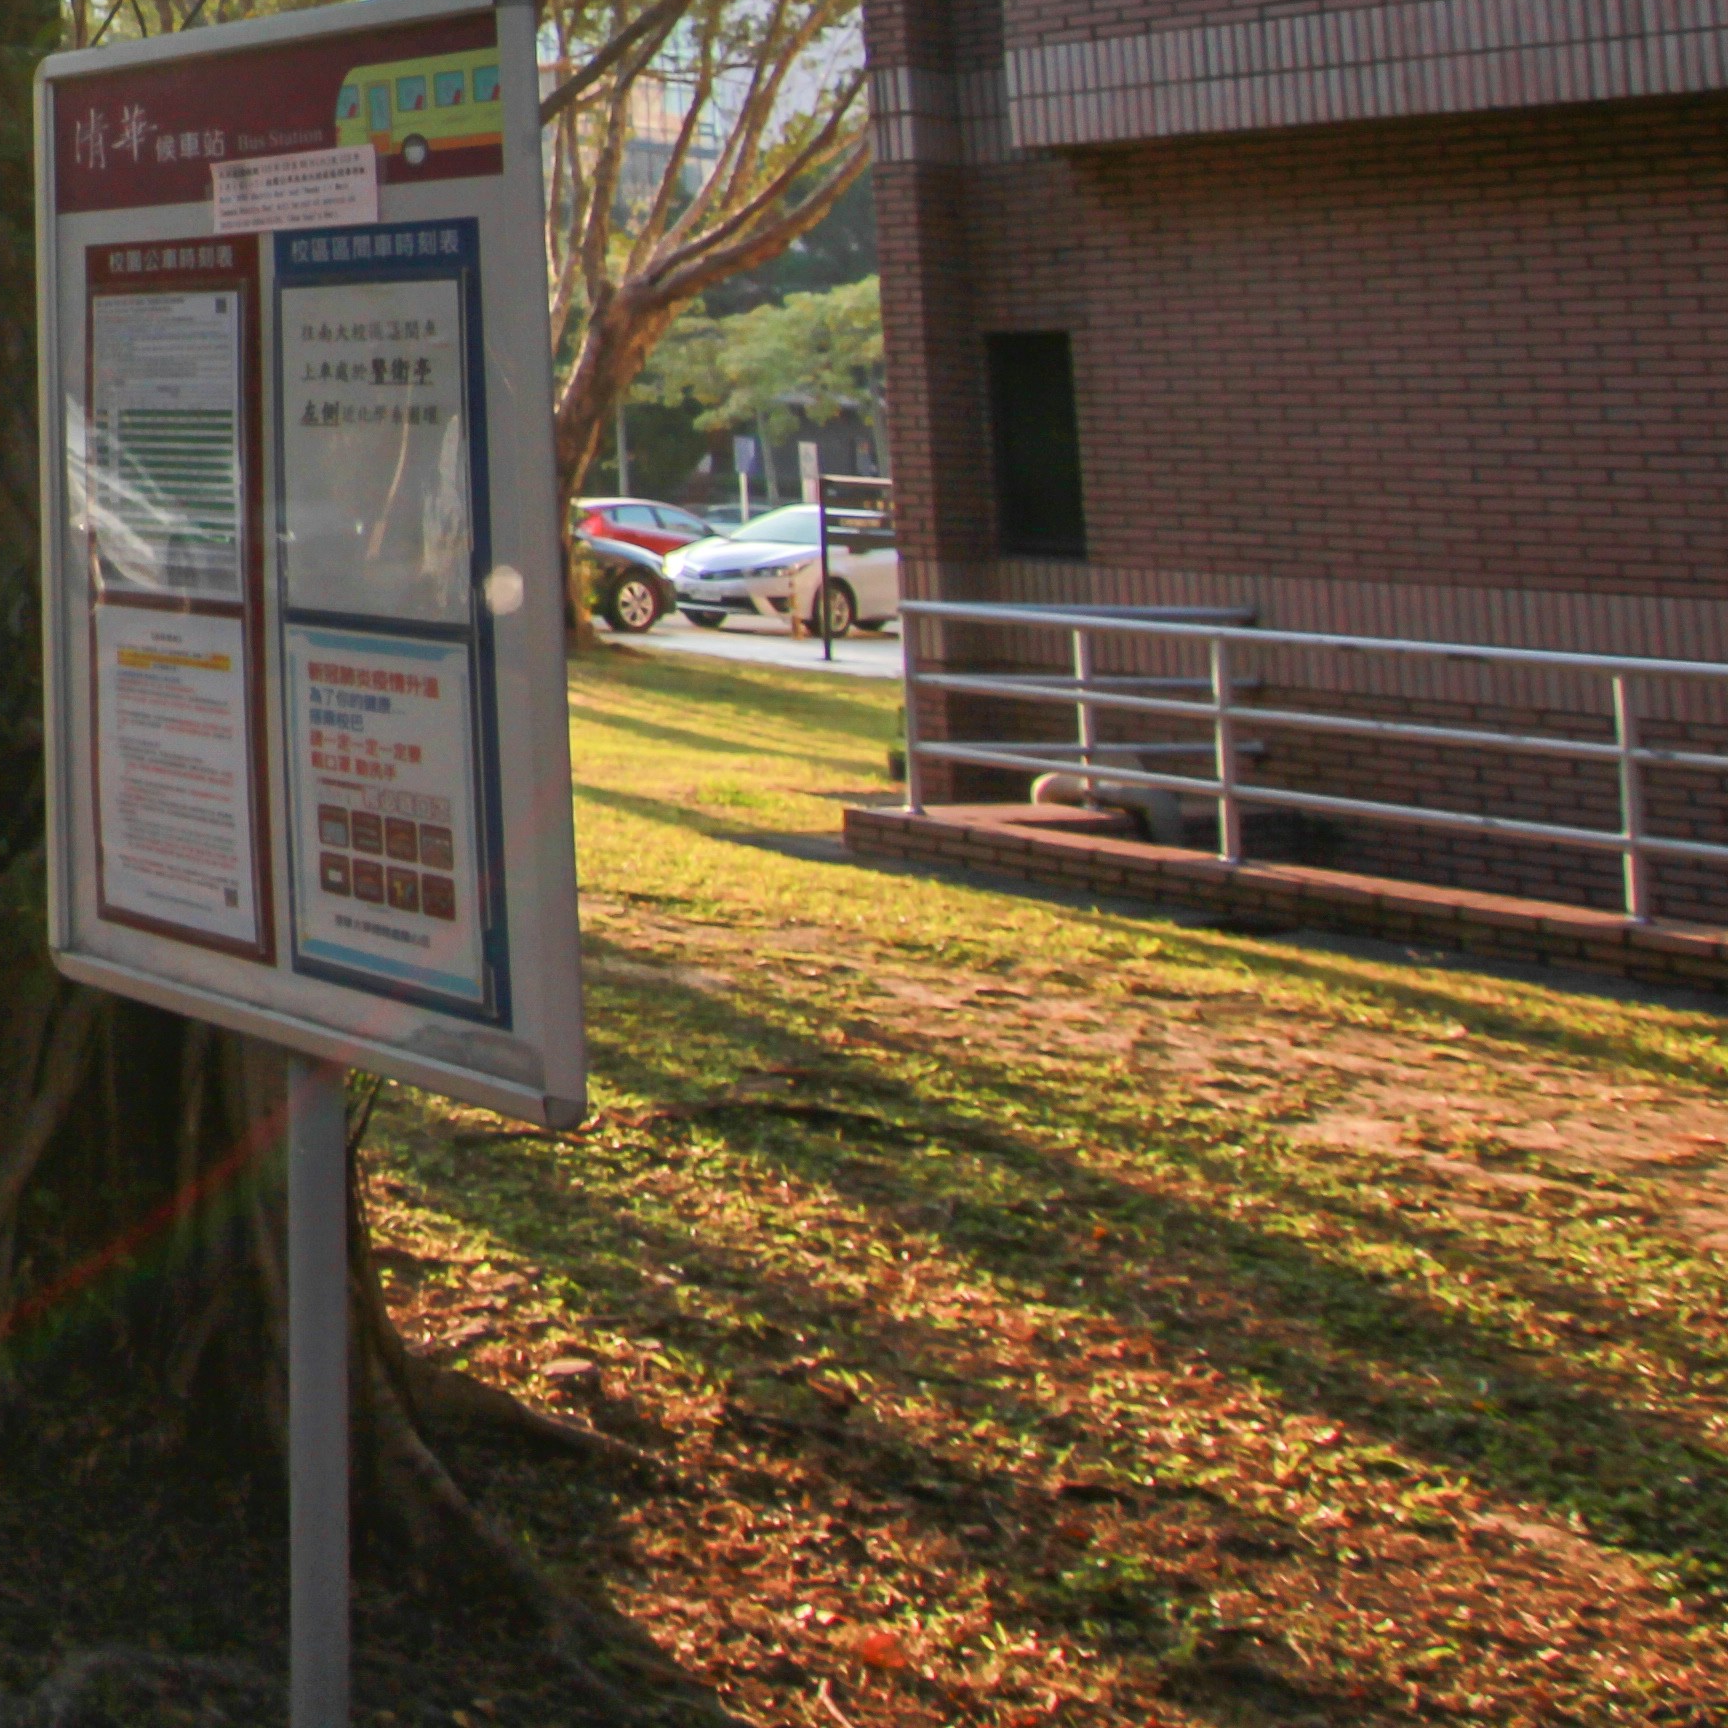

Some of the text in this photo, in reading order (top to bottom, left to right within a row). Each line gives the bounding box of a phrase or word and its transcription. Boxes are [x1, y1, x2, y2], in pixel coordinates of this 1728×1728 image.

[156, 129, 226, 163] 候車站
[238, 128, 323, 150] Bus Station
[109, 244, 233, 272] 校園公車時刻表
[291, 229, 459, 264] 校區區間車時刻表
